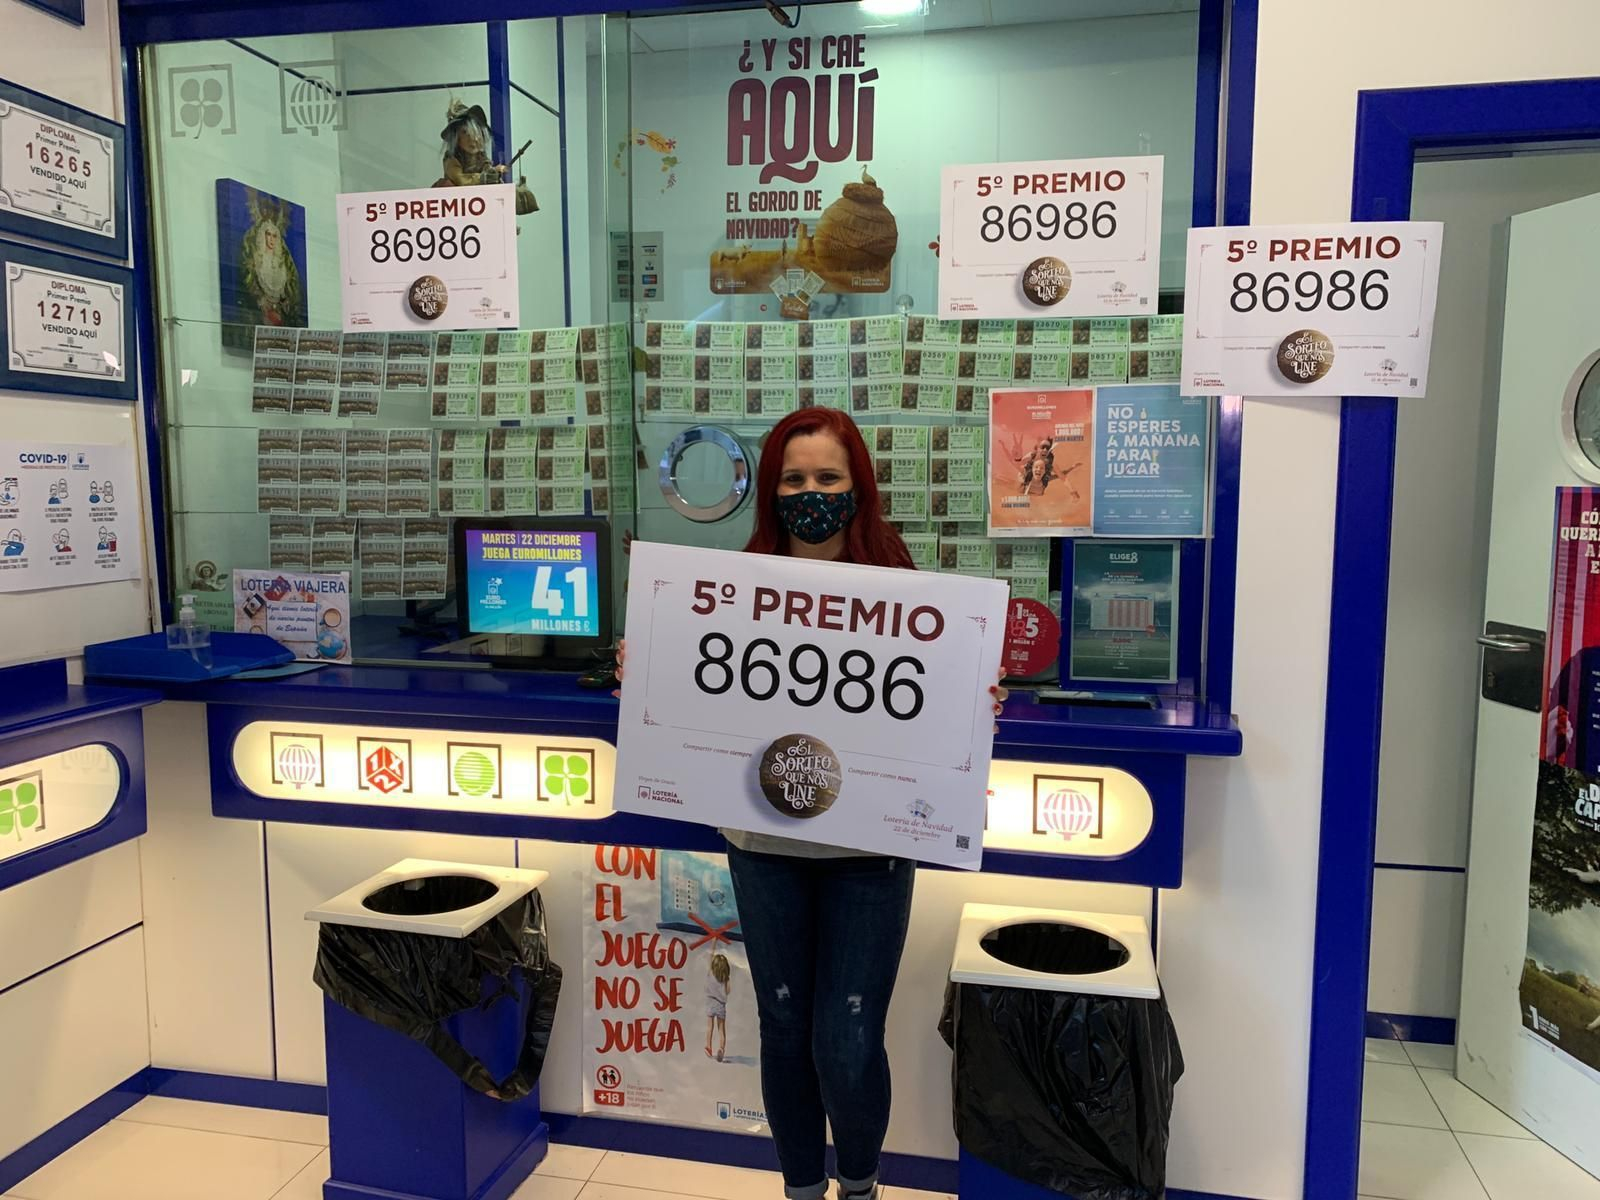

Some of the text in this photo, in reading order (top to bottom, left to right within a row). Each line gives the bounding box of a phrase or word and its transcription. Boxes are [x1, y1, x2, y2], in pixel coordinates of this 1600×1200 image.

[788, 37, 811, 69] SI
[821, 34, 866, 69] CAE
[40, 123, 76, 143] DIPLOMA
[727, 67, 879, 184] AQUÍ
[36, 132, 80, 154] Primer Premio
[25, 142, 91, 177] 16265
[30, 165, 67, 183] VENDIDO
[1013, 170, 1126, 195] PREMIO
[395, 197, 486, 220] PREMIO
[726, 190, 822, 213] EL GORDO DE
[726, 218, 799, 240] NAVIDAD?
[980, 200, 1117, 243] 86986
[370, 224, 481, 263] 86986
[1269, 235, 1401, 262] PREMIO
[51, 281, 87, 294] DIPLOMA
[1034, 285, 1057, 301] UNE
[1230, 269, 1390, 313] 86986
[47, 290, 91, 305] Primer Premio
[37, 300, 101, 326] 12719
[42, 323, 78, 336] VENDIDO
[1284, 341, 1327, 359] SORTEO
[1290, 361, 1317, 378] UNE
[1108, 407, 1133, 419] NO
[1108, 420, 1181, 433] ESPERES
[1107, 431, 1200, 448] A MAÑANA
[19, 453, 67, 464] COVID-19
[1107, 449, 1152, 462] PARA
[1105, 463, 1160, 478] JUGAR
[1581, 507, 1600, 525] CÓ
[482, 533, 581, 546] MARTES 22 DICIEMBRE
[1560, 526, 1600, 541] QUER
[482, 547, 582, 561] JUEGA EUROMILLONES
[294, 580, 346, 593] VIAJERA
[531, 566, 588, 617] 41
[752, 586, 945, 642] PREMIO
[531, 619, 581, 631] MILLONES
[694, 632, 926, 721] 86986
[683, 743, 713, 753] Compartir
[771, 752, 831, 776] SORTEO
[848, 767, 879, 777] Compartir
[785, 770, 828, 789] QUE NOS
[652, 789, 678, 798] LOTERÍA
[652, 795, 684, 805] NACIONAL
[779, 782, 816, 809] UNE
[883, 815, 954, 833] Lotería de Navidad
[902, 826, 909, 834] de
[911, 827, 941, 838] diciembre
[595, 843, 656, 881] CON
[595, 883, 628, 922] EL
[595, 930, 688, 970] JUEGO
[595, 975, 684, 1013] NO SE
[595, 1018, 686, 1053] JUEGA
[598, 1093, 620, 1104] +18
